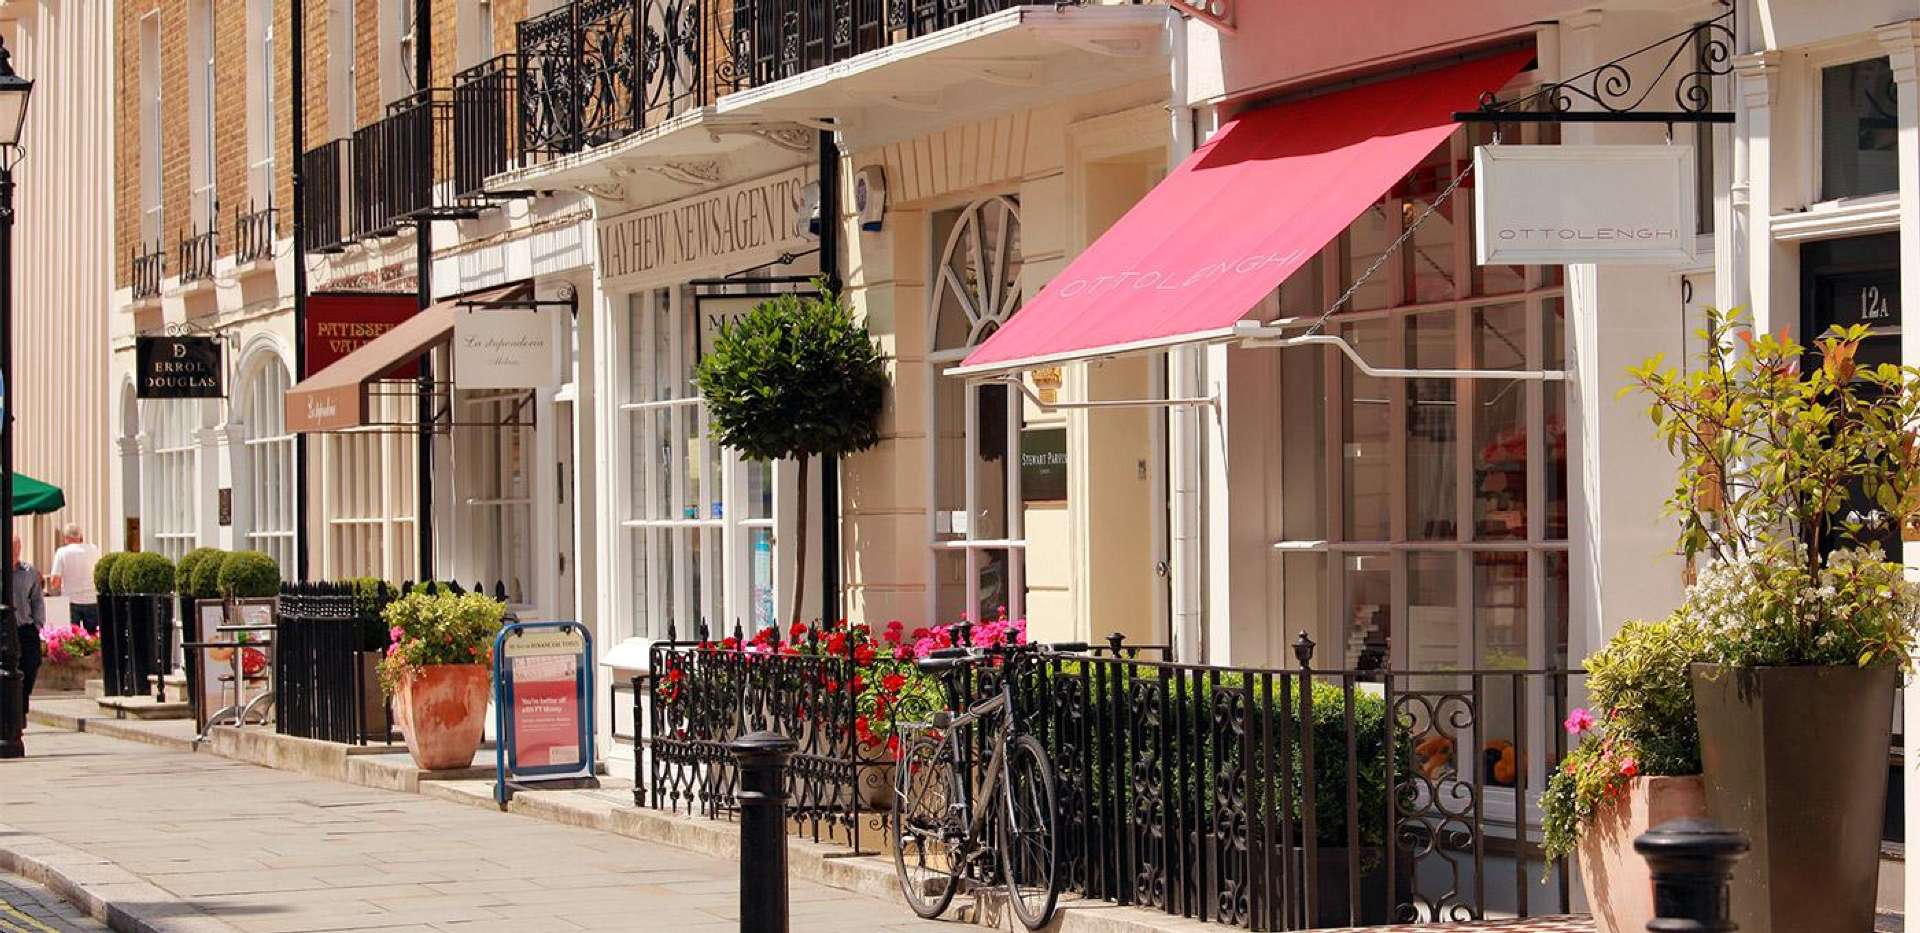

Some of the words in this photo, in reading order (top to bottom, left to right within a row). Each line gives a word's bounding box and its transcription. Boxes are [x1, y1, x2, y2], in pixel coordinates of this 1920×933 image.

[597, 211, 669, 279] MAYHEW
[672, 177, 805, 264] NEWSAGENTS
[1498, 229, 1679, 240] OTTOLENGHI
[1060, 249, 1306, 298] OTTOLENGHI
[1862, 286, 1889, 319] 12A
[155, 361, 205, 373] ERROL
[145, 376, 216, 387] DOUGLAS
